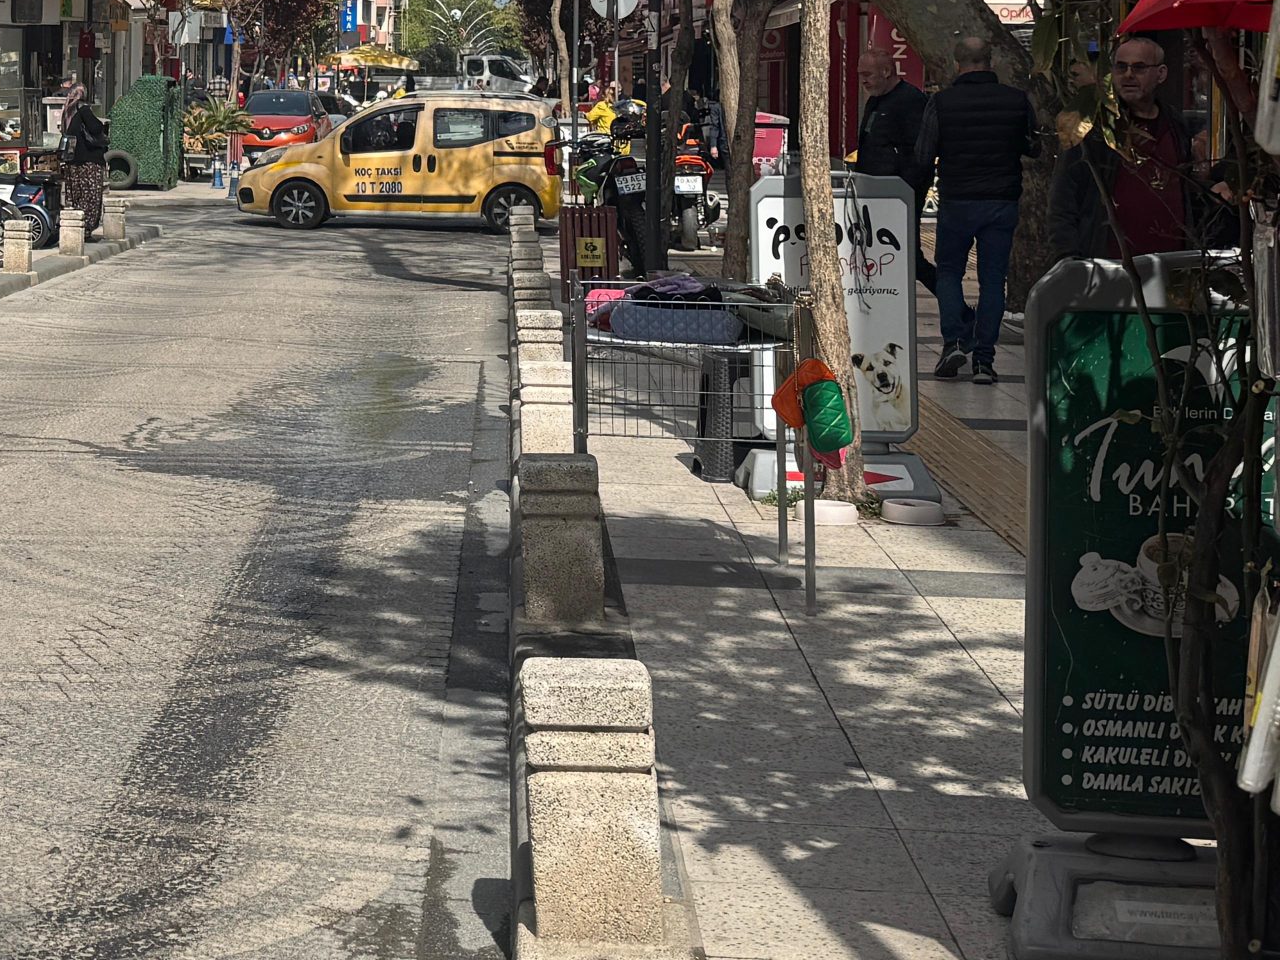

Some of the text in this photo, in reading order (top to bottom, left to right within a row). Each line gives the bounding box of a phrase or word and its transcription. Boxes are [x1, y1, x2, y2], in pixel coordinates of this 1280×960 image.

[354, 165, 402, 178] KOÇ TAKSİ
[356, 181, 403, 194] 10 T 2080
[1081, 688, 1140, 712] SÜTLÜ
[1082, 719, 1166, 740] OSMANLI
[1081, 744, 1170, 767] KAKULELİ
[1081, 772, 1202, 797] DAMLA SAKIZ
